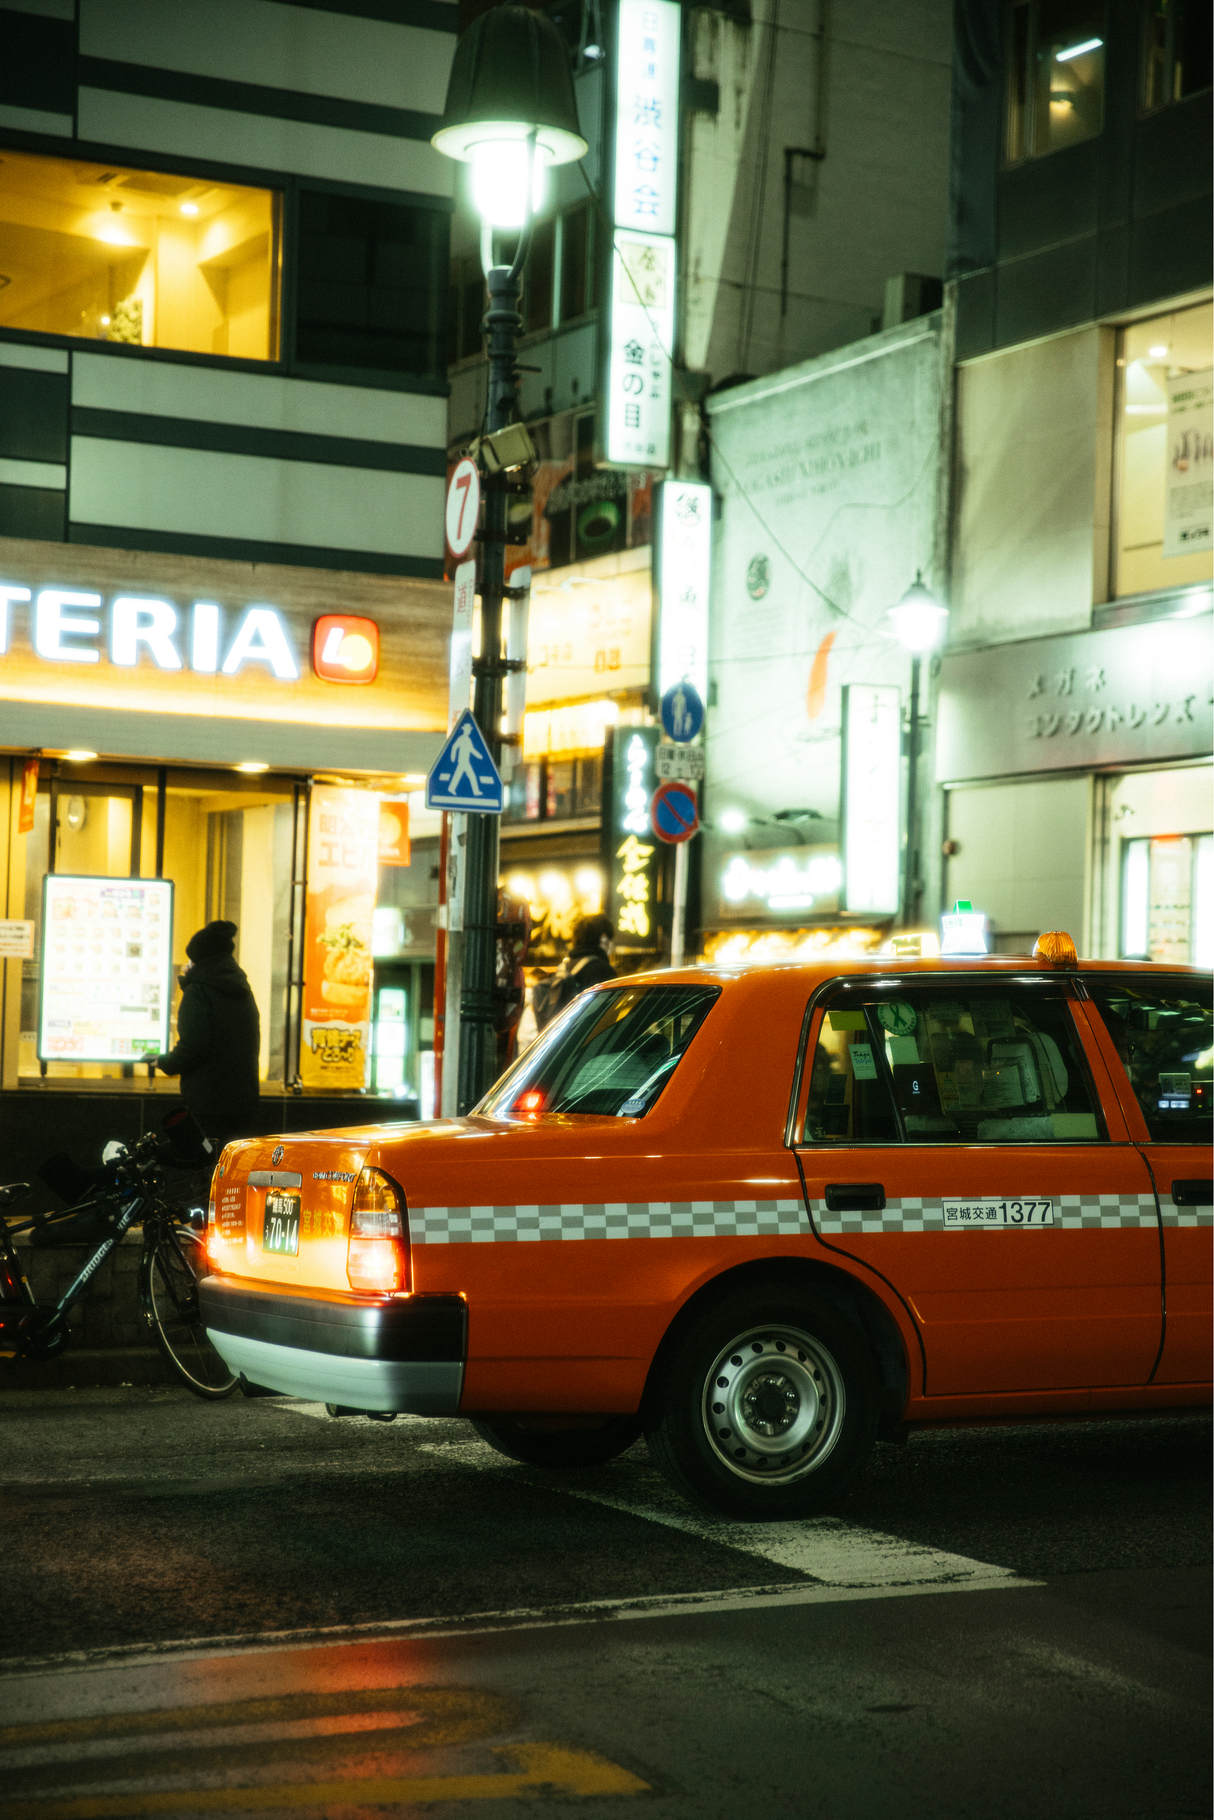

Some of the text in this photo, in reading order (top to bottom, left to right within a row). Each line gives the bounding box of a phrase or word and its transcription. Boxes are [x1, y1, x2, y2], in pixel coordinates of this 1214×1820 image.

[633, 95, 662, 216] 渋谷会
[622, 338, 645, 428] 金の目
[456, 473, 472, 540] 7
[1026, 665, 1107, 701] メガネ
[1026, 694, 1196, 739] コンタクトレンズ
[912, 1080, 919, 1091] G
[283, 1198, 294, 1216] 500
[303, 1208, 345, 1238] 宮城交通
[946, 1202, 1051, 1223] 宮城交通 1377
[269, 1217, 298, 1252] 70-14
